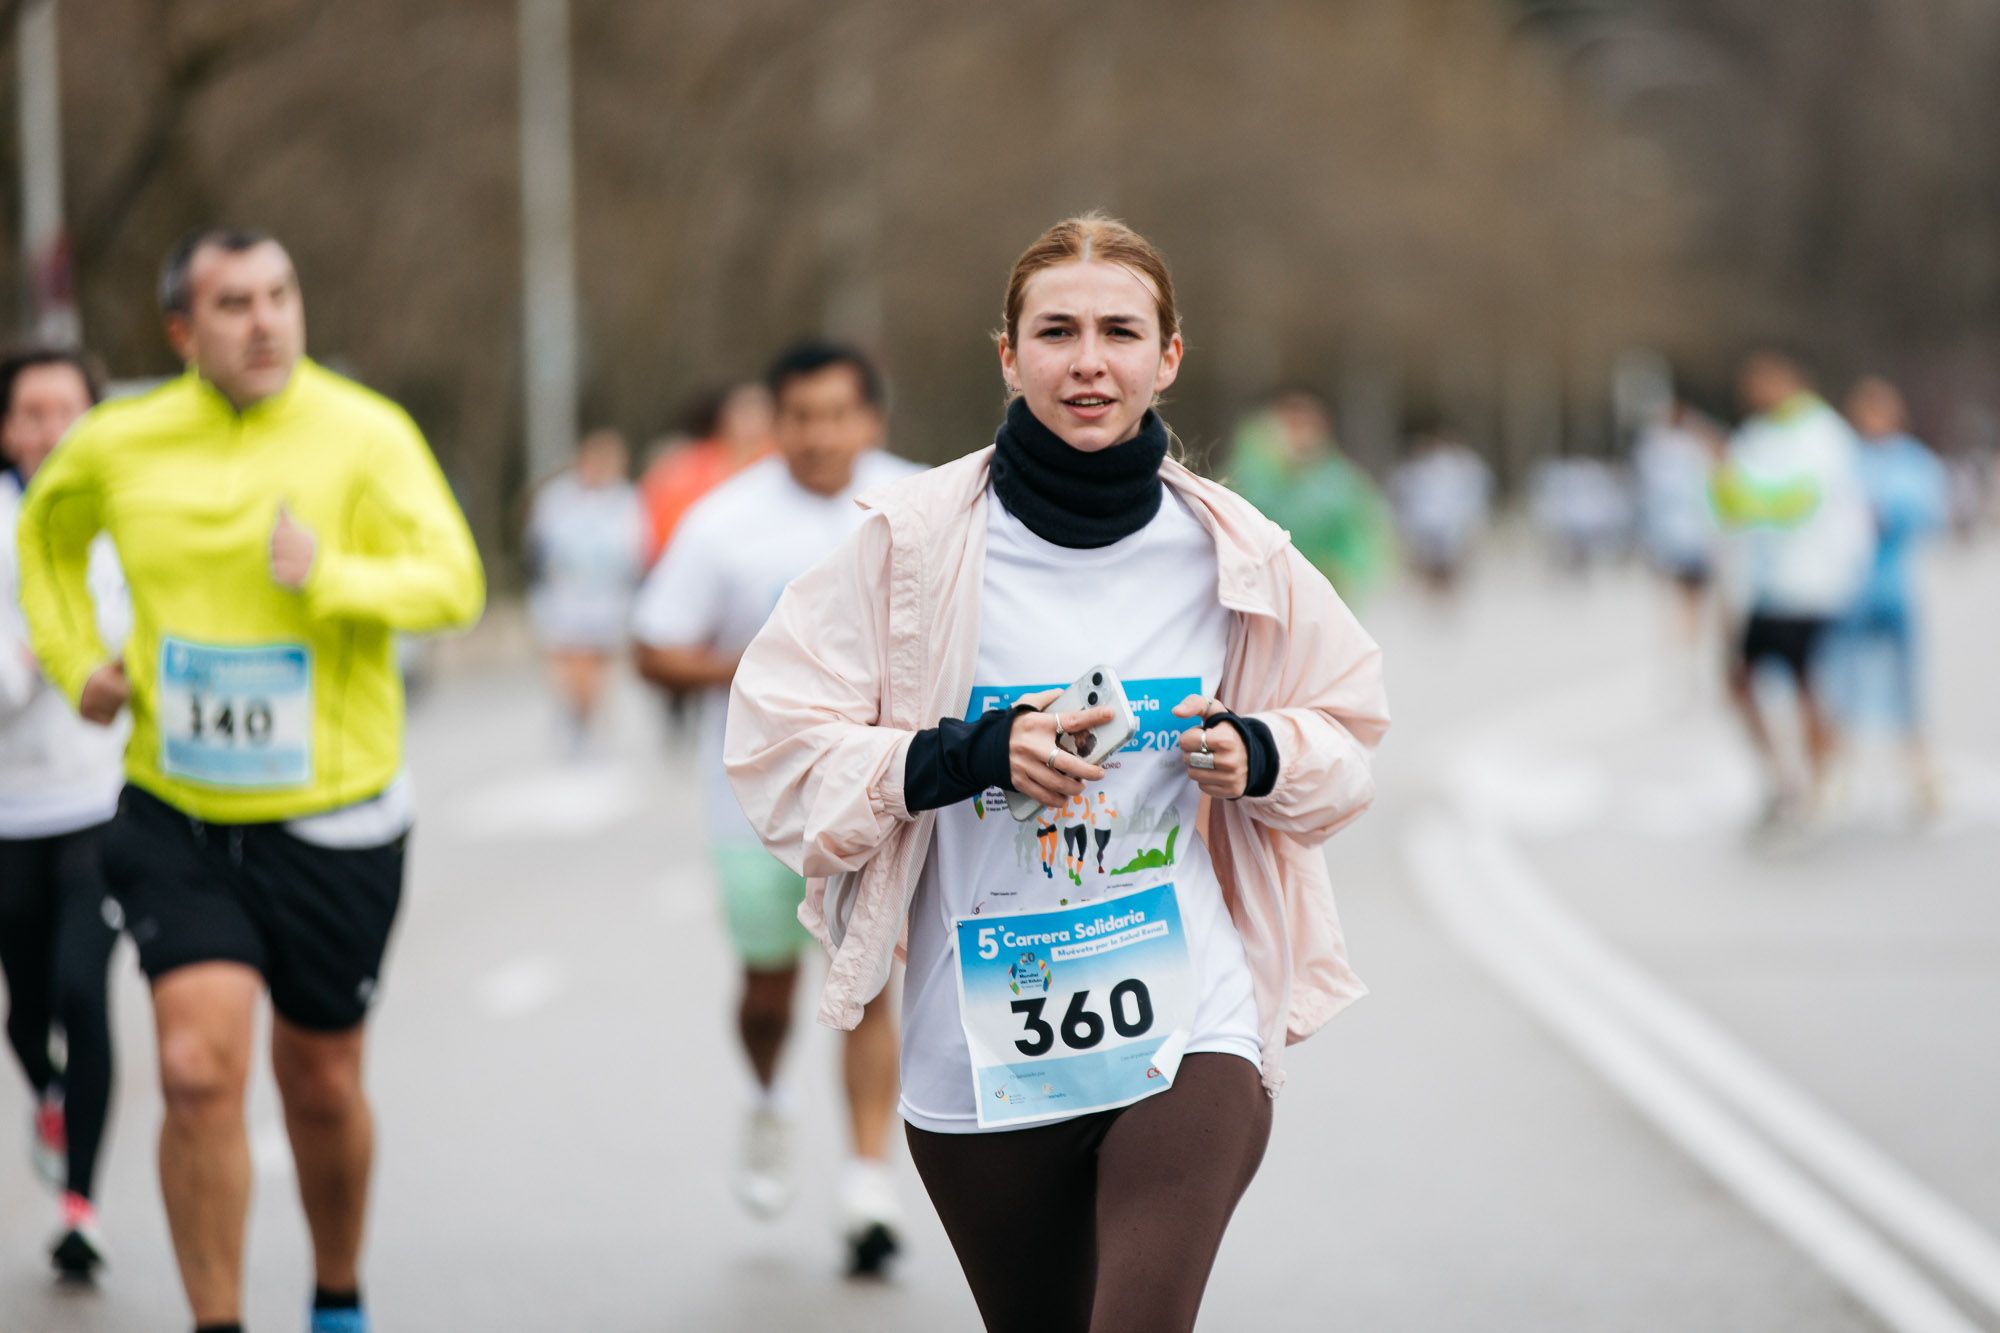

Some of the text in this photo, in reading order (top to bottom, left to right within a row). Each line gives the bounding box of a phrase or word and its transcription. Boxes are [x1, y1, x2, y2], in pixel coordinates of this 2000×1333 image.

[1141, 730, 1181, 751] 202
[1003, 930, 1070, 948] Carrera
[1074, 909, 1146, 939] Solidaria
[1057, 946, 1094, 957] Muévete
[1095, 943, 1110, 952] por
[1120, 931, 1141, 942] Salud
[1141, 923, 1164, 935] Renal
[1010, 978, 1154, 1057] 360
[1146, 1067, 1162, 1079] CS
